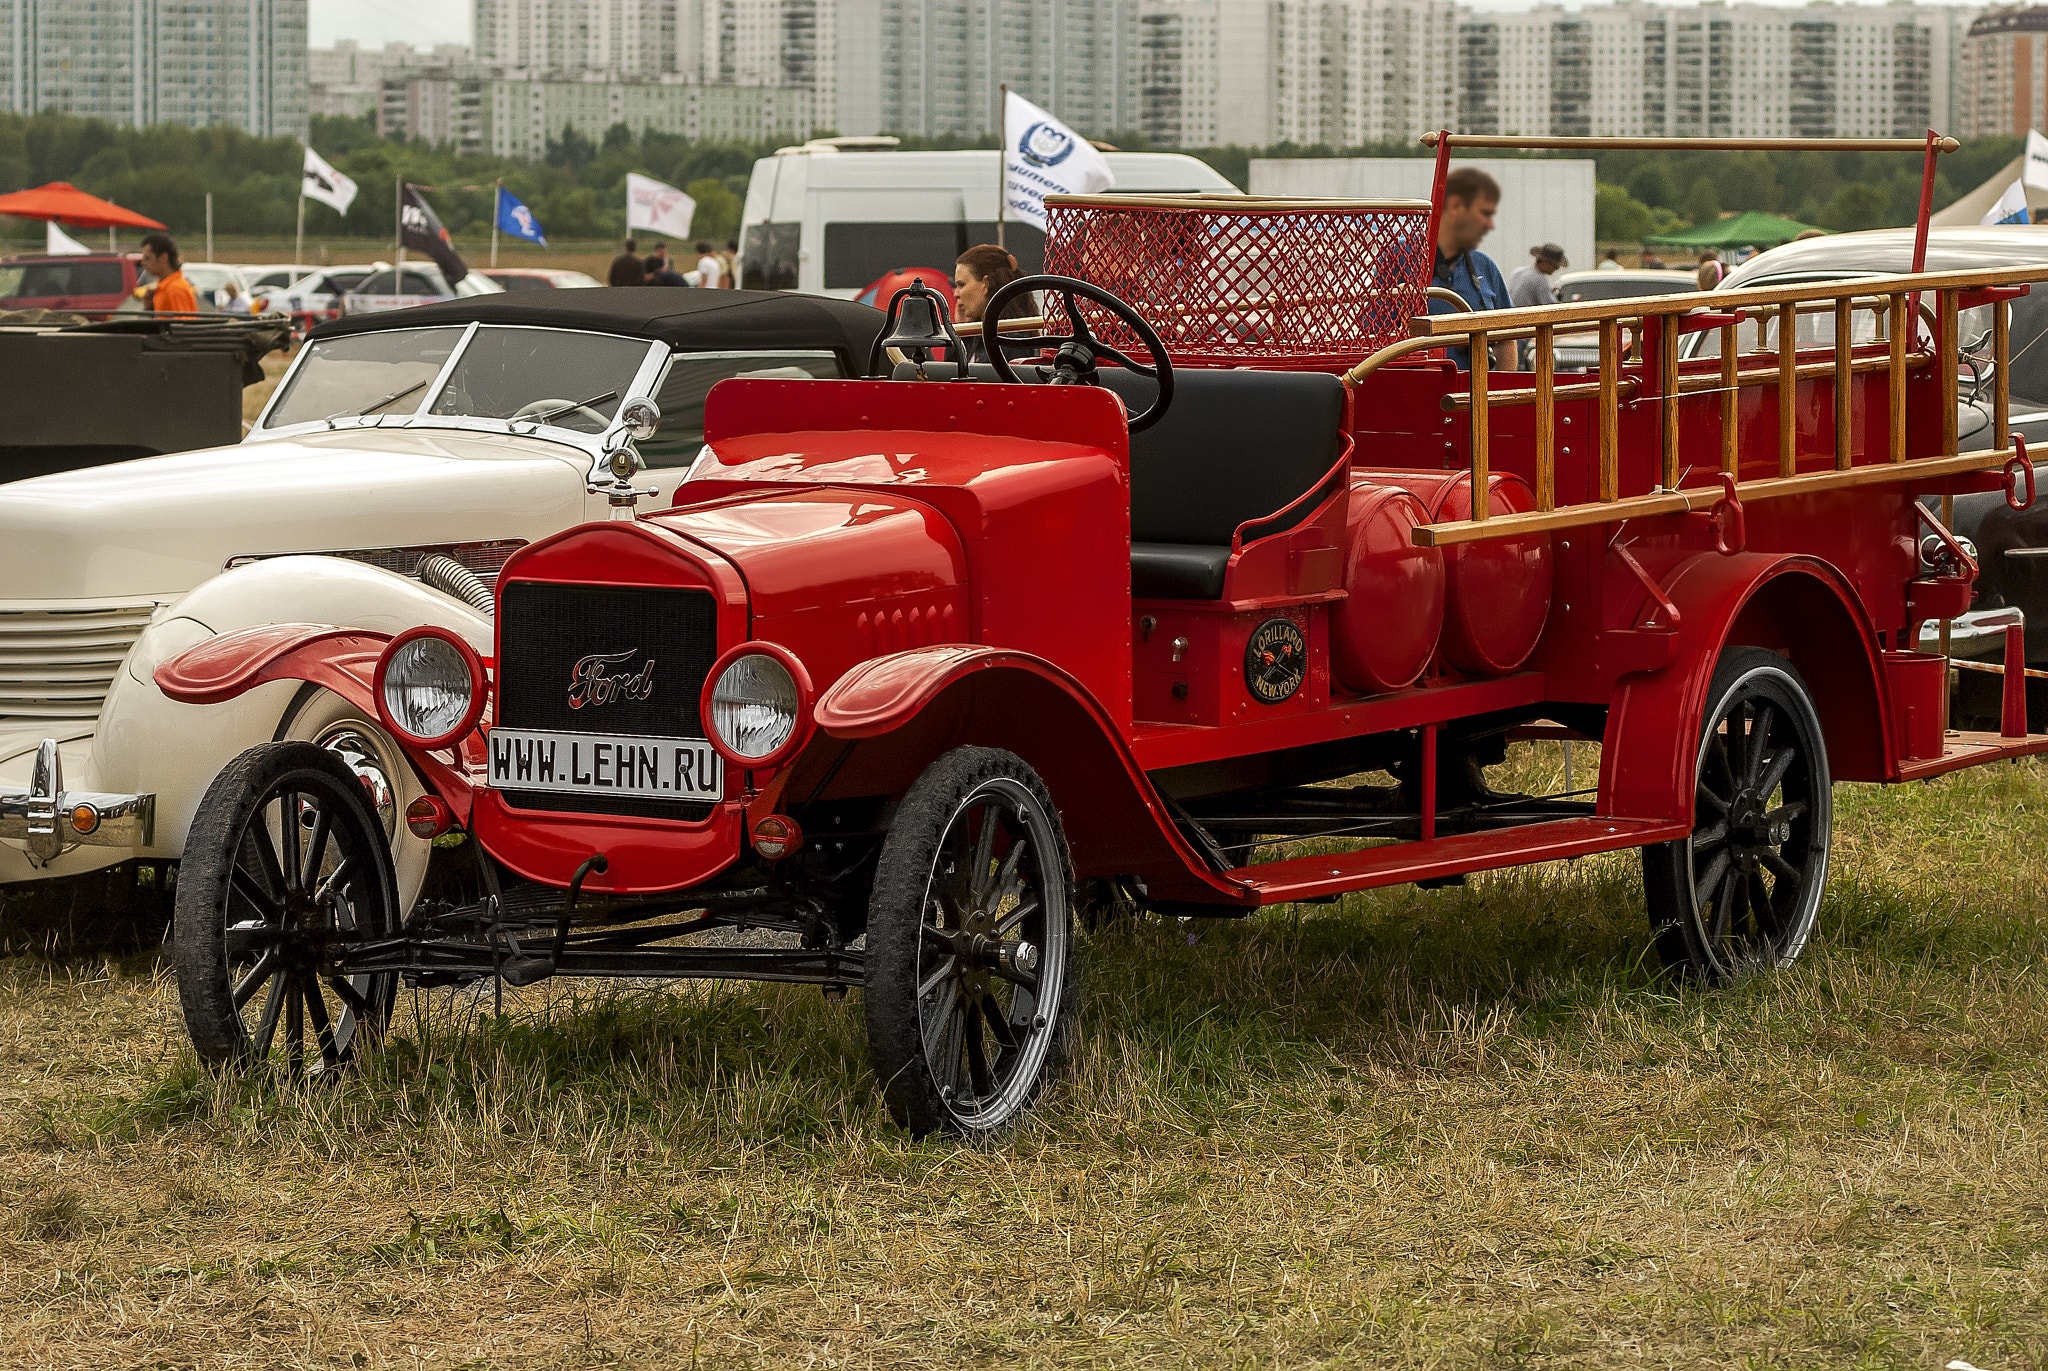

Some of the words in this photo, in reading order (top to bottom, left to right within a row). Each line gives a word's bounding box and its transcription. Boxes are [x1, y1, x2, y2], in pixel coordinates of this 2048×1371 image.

[1253, 625, 1303, 658] LORILLARD
[567, 648, 656, 710] Ford
[492, 737, 717, 793] WWW.LEHN.RU
